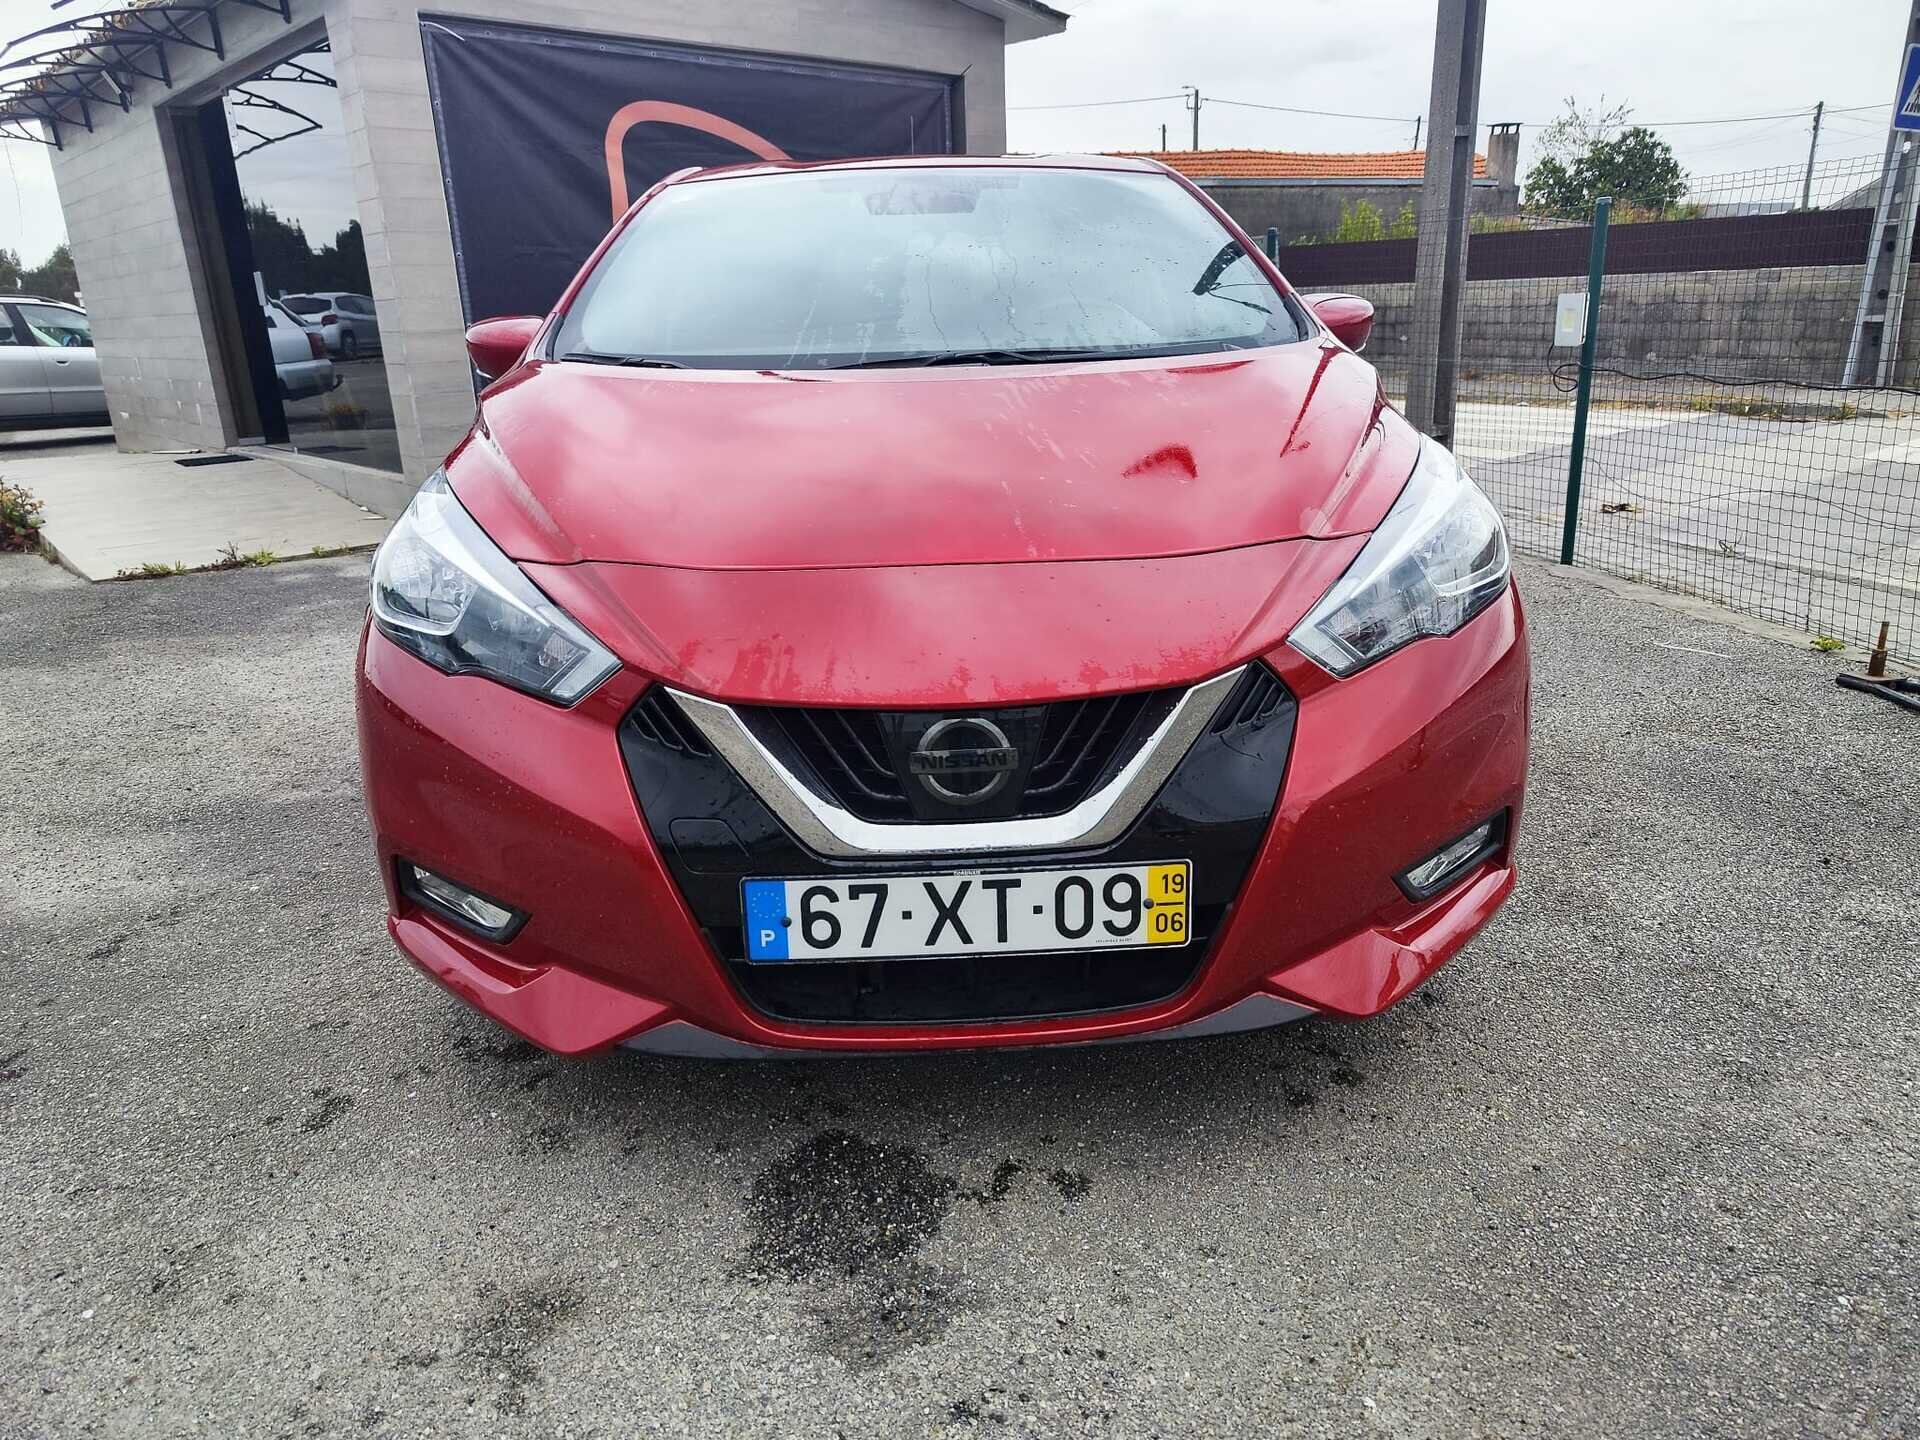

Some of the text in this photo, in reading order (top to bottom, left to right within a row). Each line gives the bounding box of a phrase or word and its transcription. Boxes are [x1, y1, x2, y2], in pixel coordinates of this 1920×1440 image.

[919, 752, 1009, 770] NISSAN
[1161, 873, 1185, 894] 19
[1155, 912, 1183, 933] 06
[760, 929, 776, 948] P
